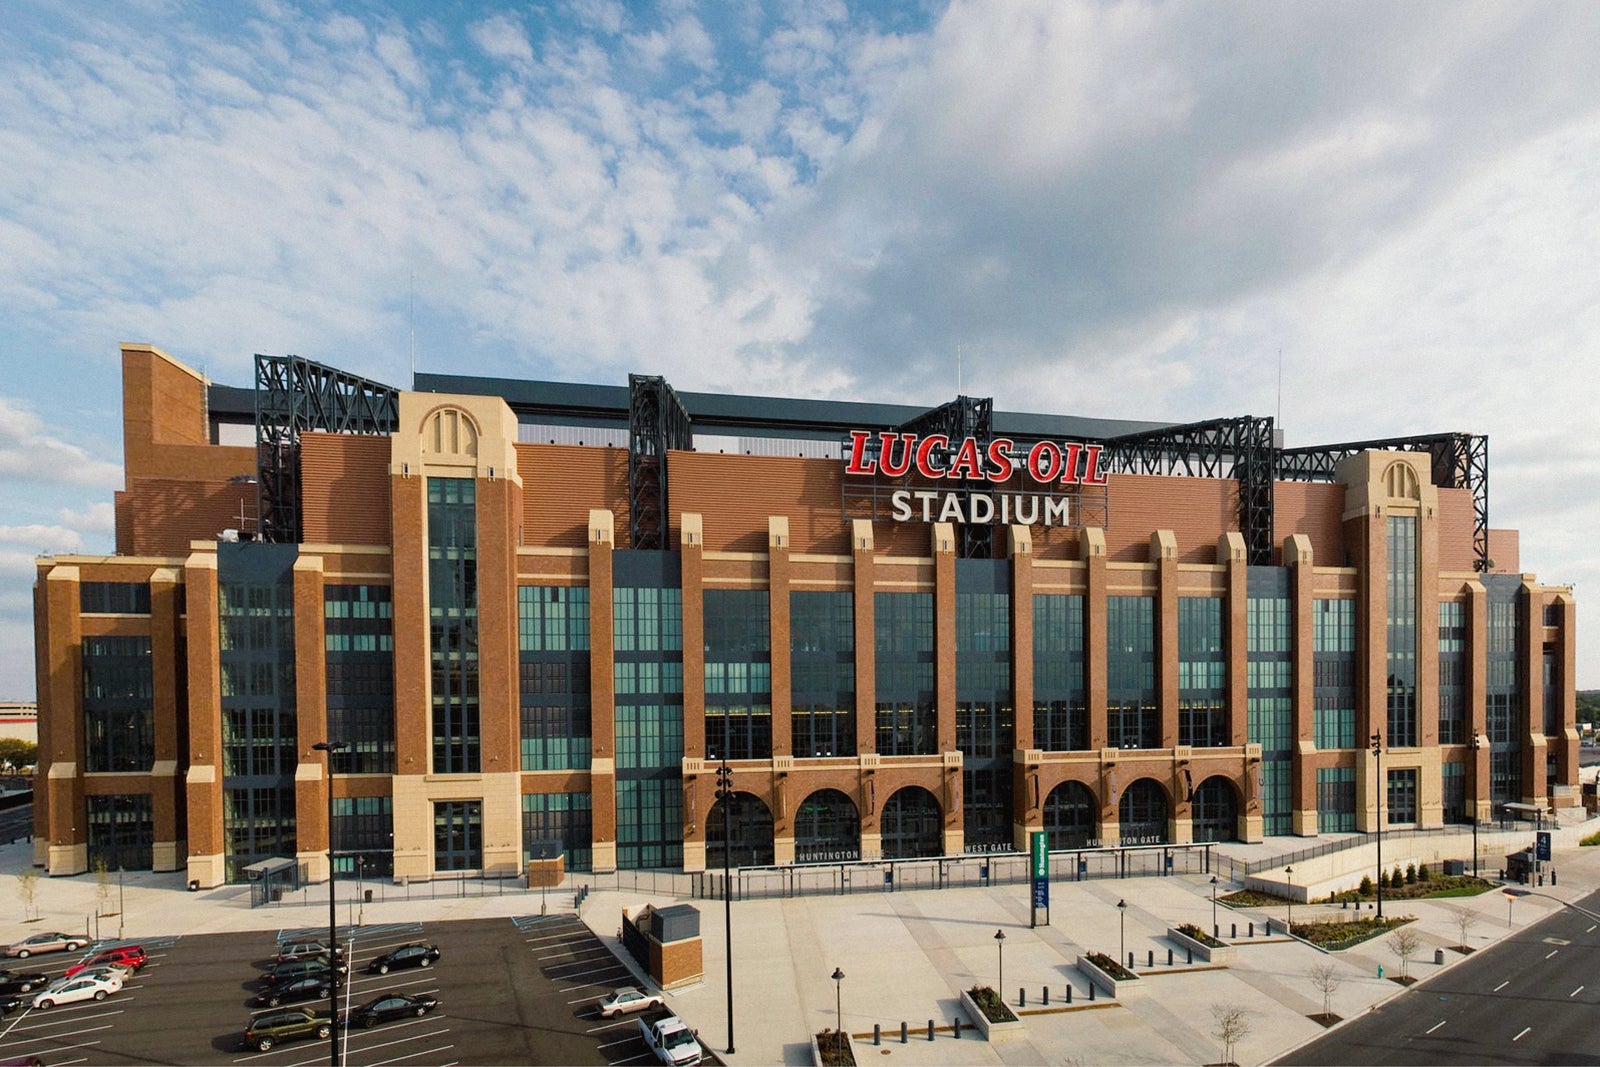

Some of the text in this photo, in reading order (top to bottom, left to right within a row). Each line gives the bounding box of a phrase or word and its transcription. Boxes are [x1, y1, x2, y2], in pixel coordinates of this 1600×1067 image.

[845, 430, 1110, 487] LUCAS OIL
[892, 490, 1070, 526] STADIUM
[1086, 835, 1160, 847] HUNTON GATE
[964, 843, 1012, 853] WEST GATE
[799, 850, 859, 861] HUNTINGTON
